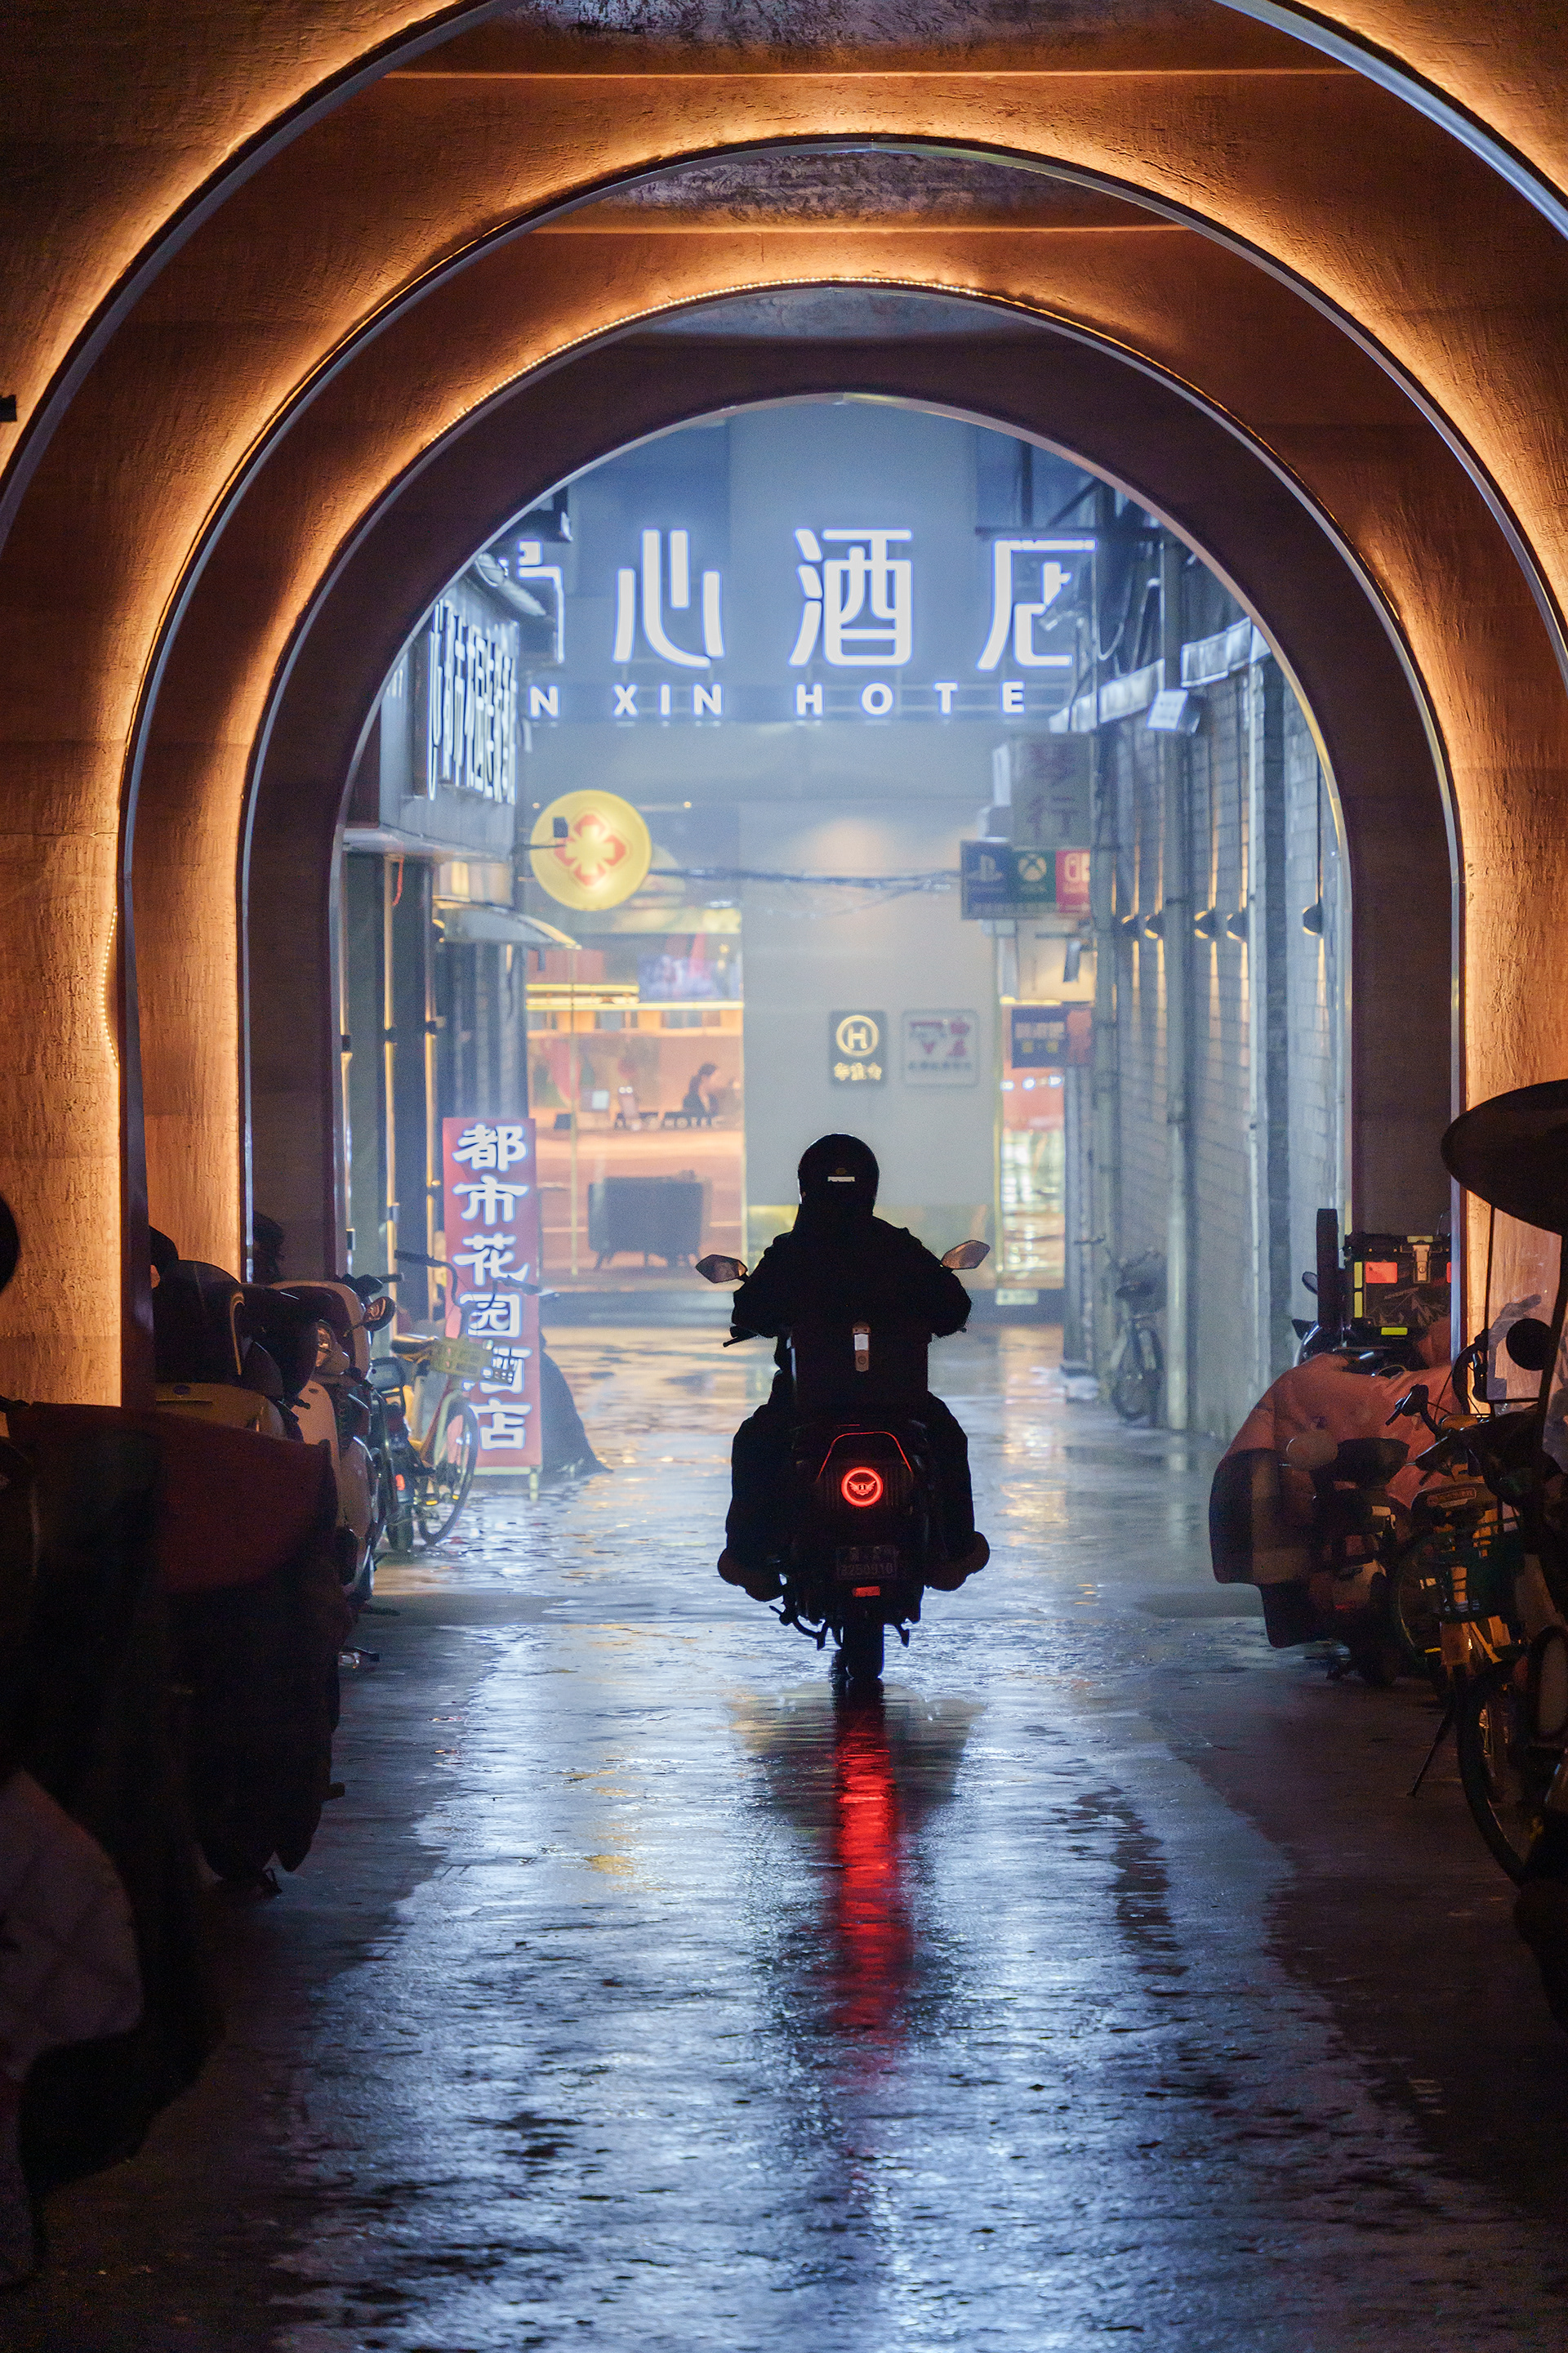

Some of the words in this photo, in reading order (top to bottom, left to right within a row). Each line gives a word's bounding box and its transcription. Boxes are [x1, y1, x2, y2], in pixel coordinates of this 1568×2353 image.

[612, 683, 723, 716] XIN
[452, 1122, 533, 1451] 都市花园酒店
